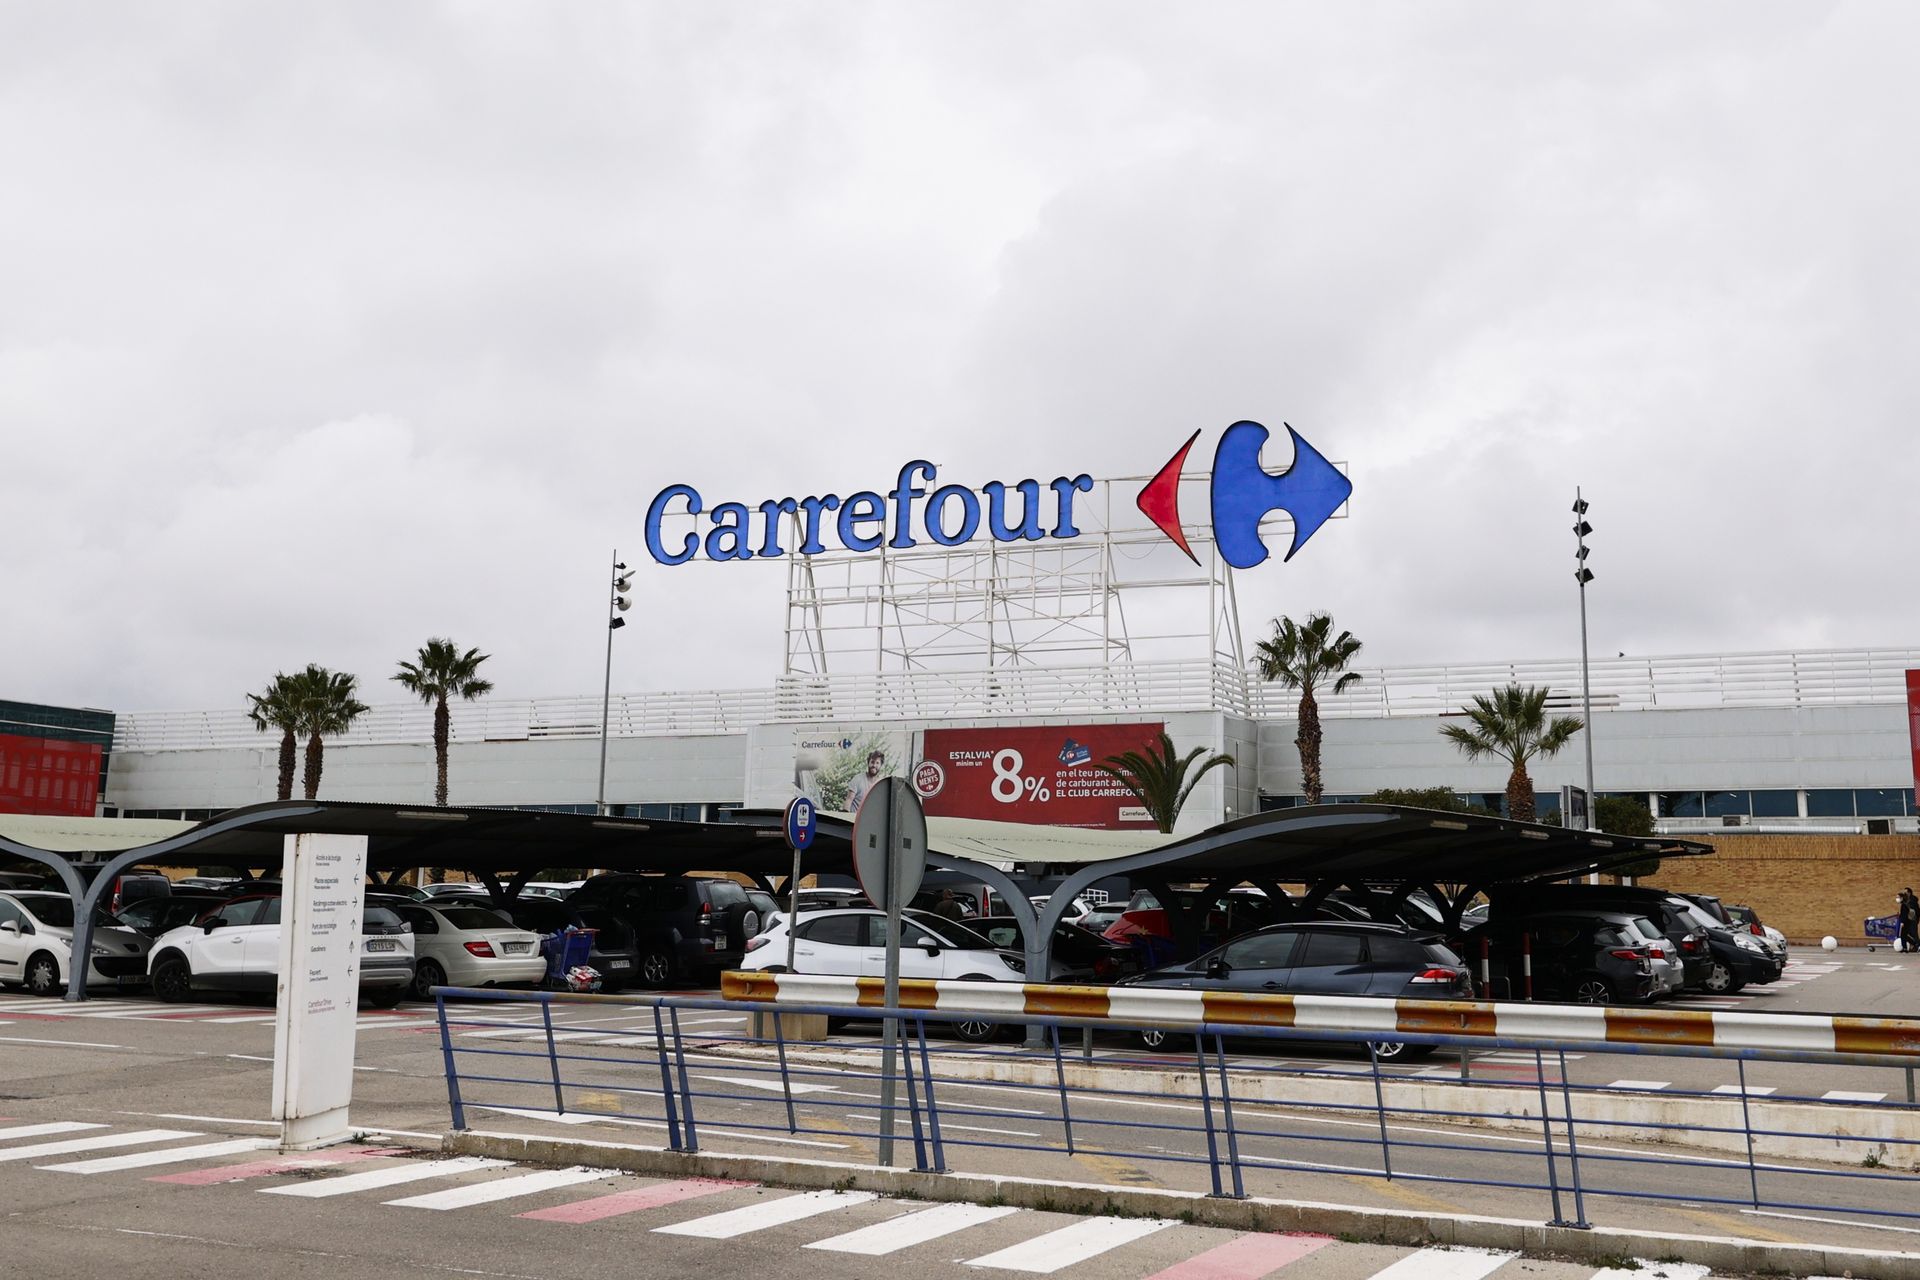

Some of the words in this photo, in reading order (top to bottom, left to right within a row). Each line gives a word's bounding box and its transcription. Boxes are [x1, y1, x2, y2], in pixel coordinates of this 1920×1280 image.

[644, 459, 1094, 566] Carrefour
[801, 740, 836, 749] Carrefour
[919, 768, 935, 778] PAGA
[1056, 770, 1067, 778] en
[1068, 768, 1077, 777] el
[1078, 769, 1093, 777] teu
[918, 774, 939, 786] MENYS
[1056, 779, 1067, 787] de
[1068, 778, 1110, 787] carburant
[1056, 789, 1067, 797] EL
[1068, 789, 1090, 797] CLUB
